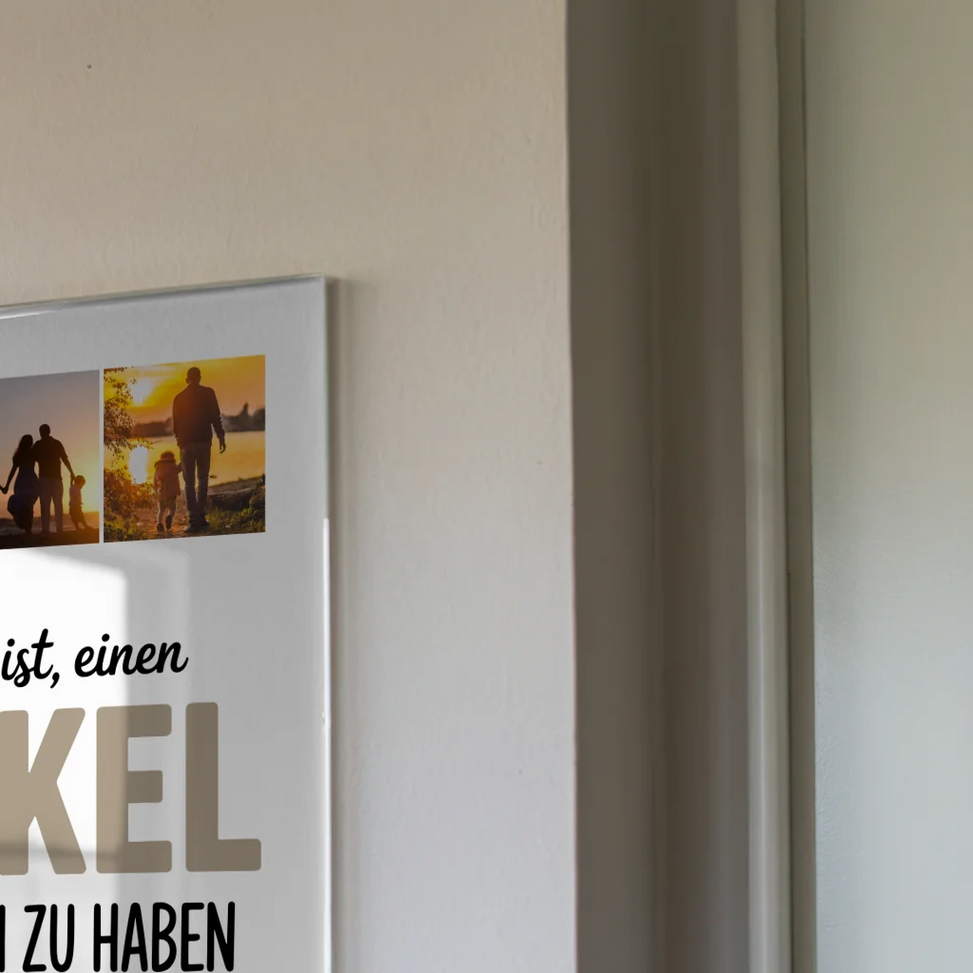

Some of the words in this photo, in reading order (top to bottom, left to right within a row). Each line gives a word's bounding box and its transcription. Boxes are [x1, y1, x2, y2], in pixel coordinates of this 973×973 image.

[1, 628, 62, 689] ist,
[74, 633, 189, 678] einen
[22, 903, 75, 973] ZU
[92, 901, 236, 973] HABEN
